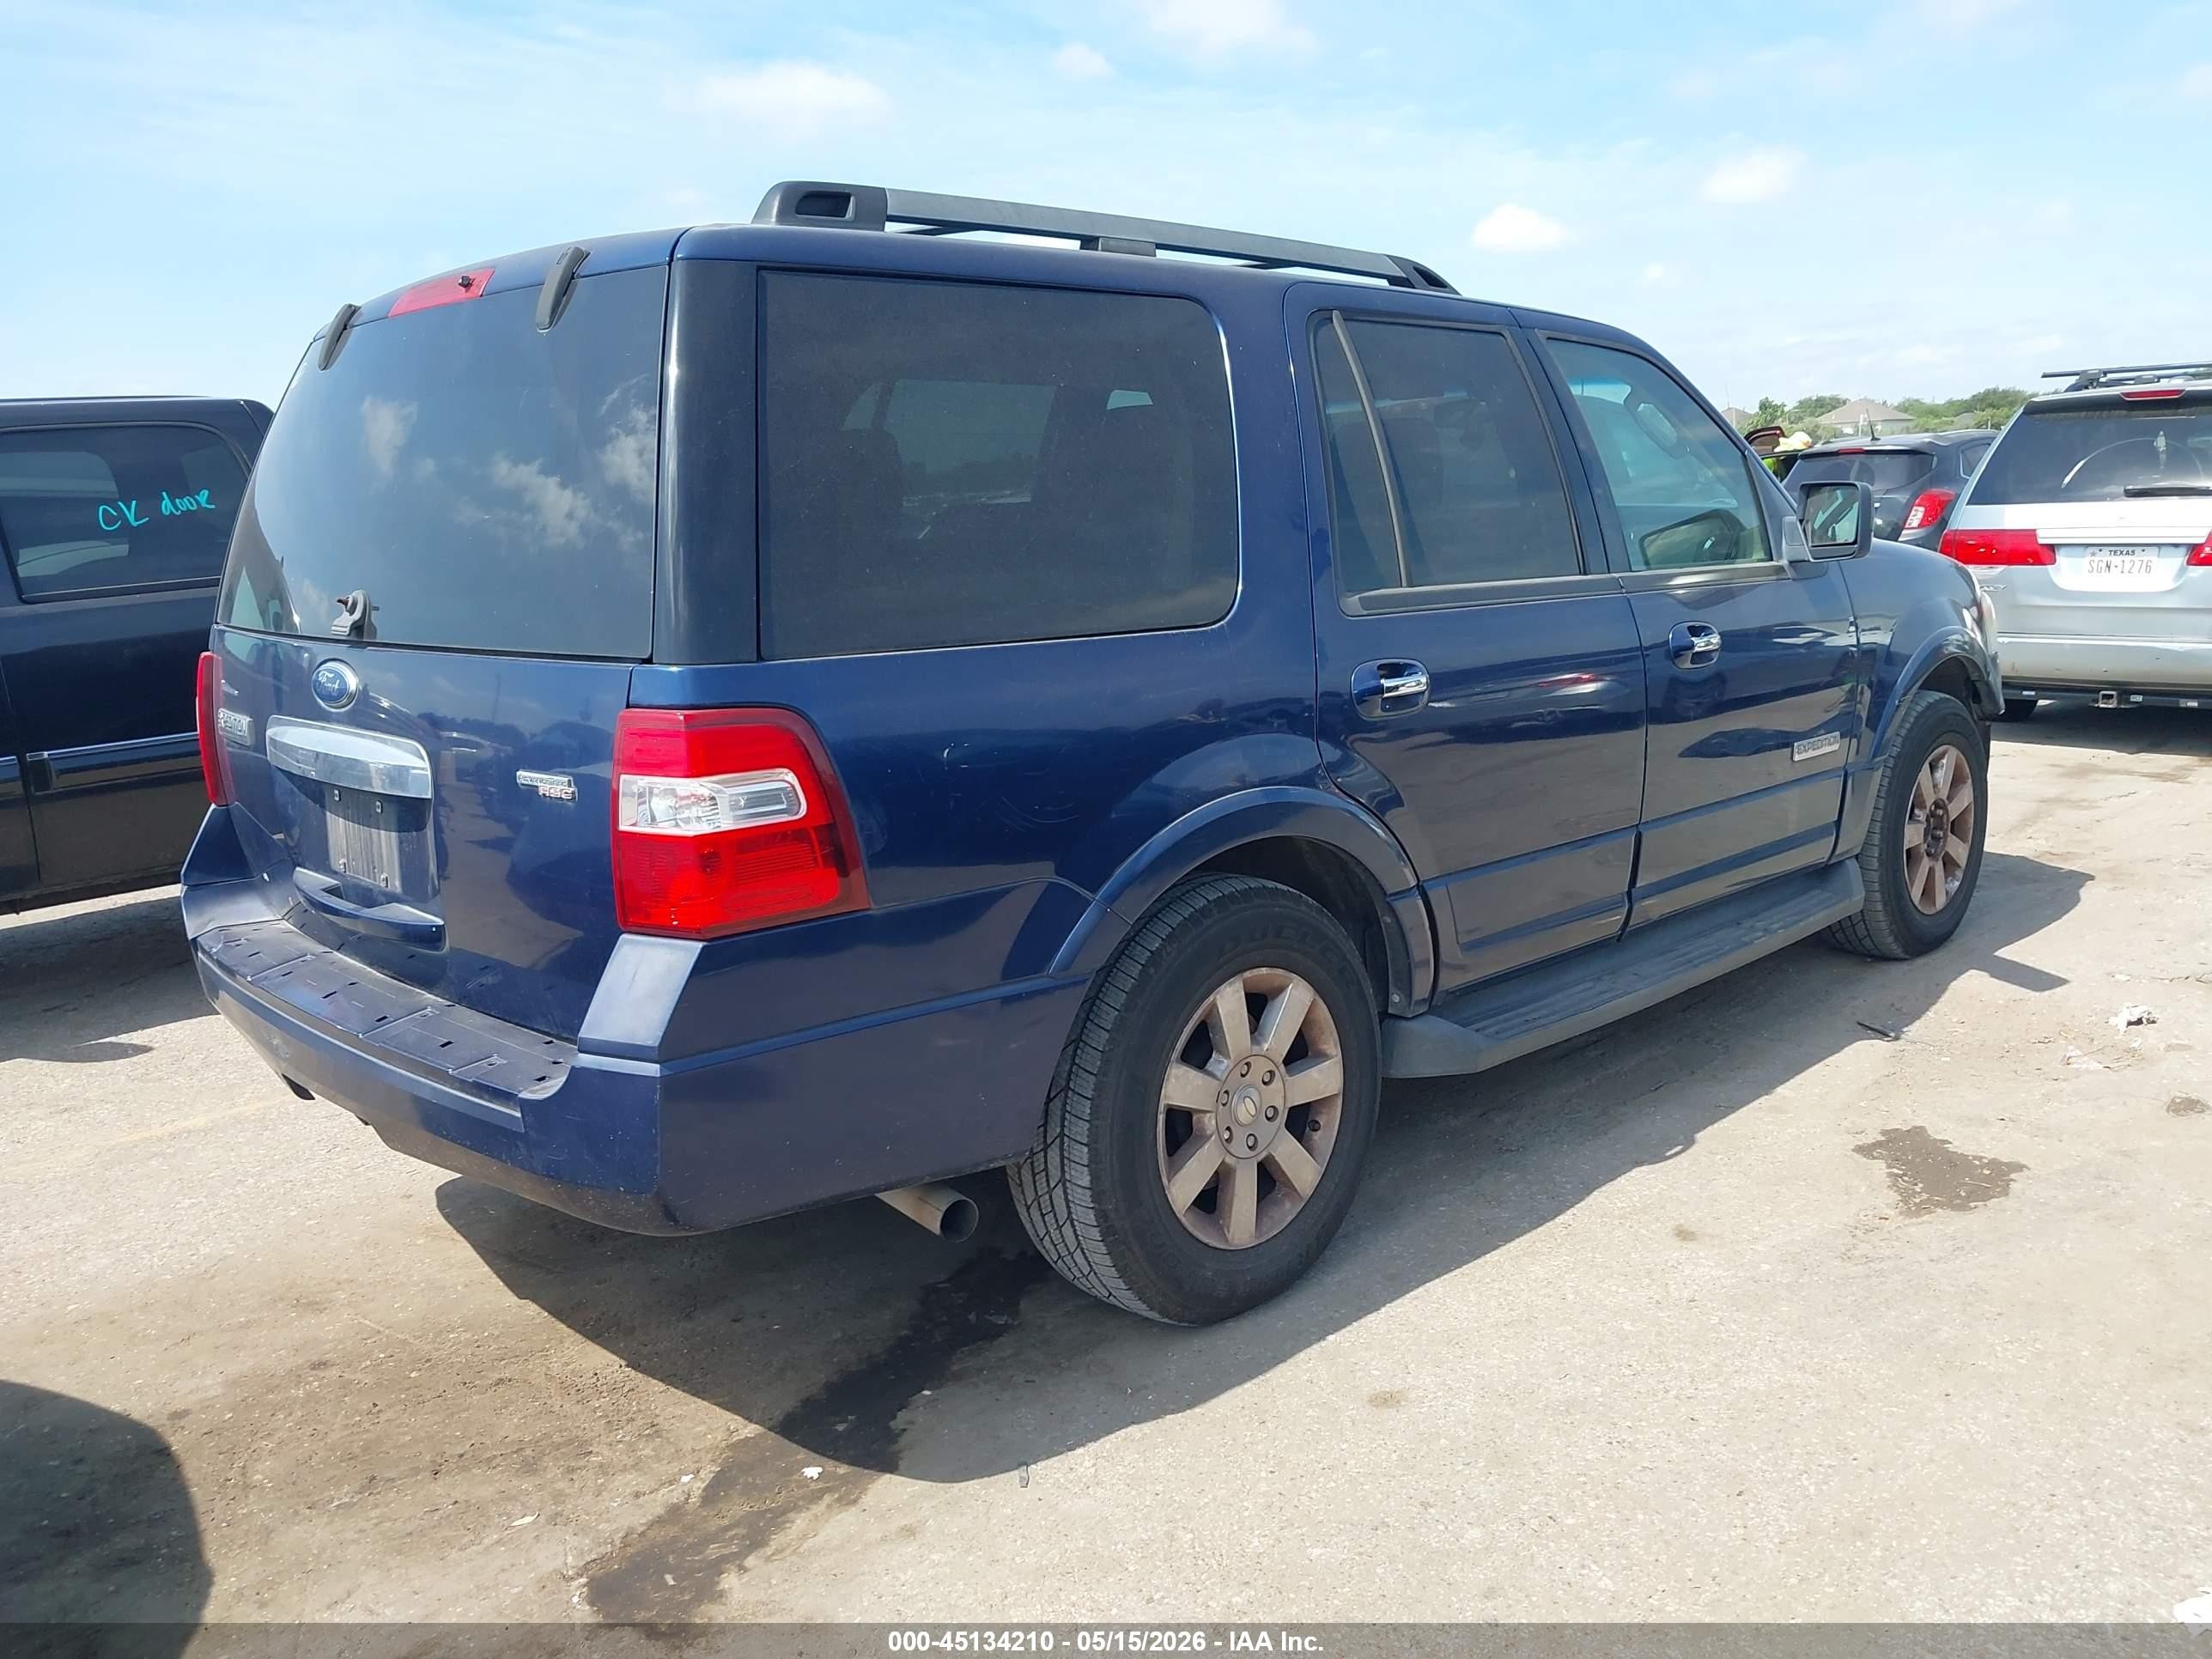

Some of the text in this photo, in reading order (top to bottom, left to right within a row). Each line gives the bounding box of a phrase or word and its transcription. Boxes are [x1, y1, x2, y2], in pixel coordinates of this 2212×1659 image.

[98, 500, 149, 531] CK
[316, 670, 342, 694] Ford
[1796, 733, 1839, 756] EXPEDITION
